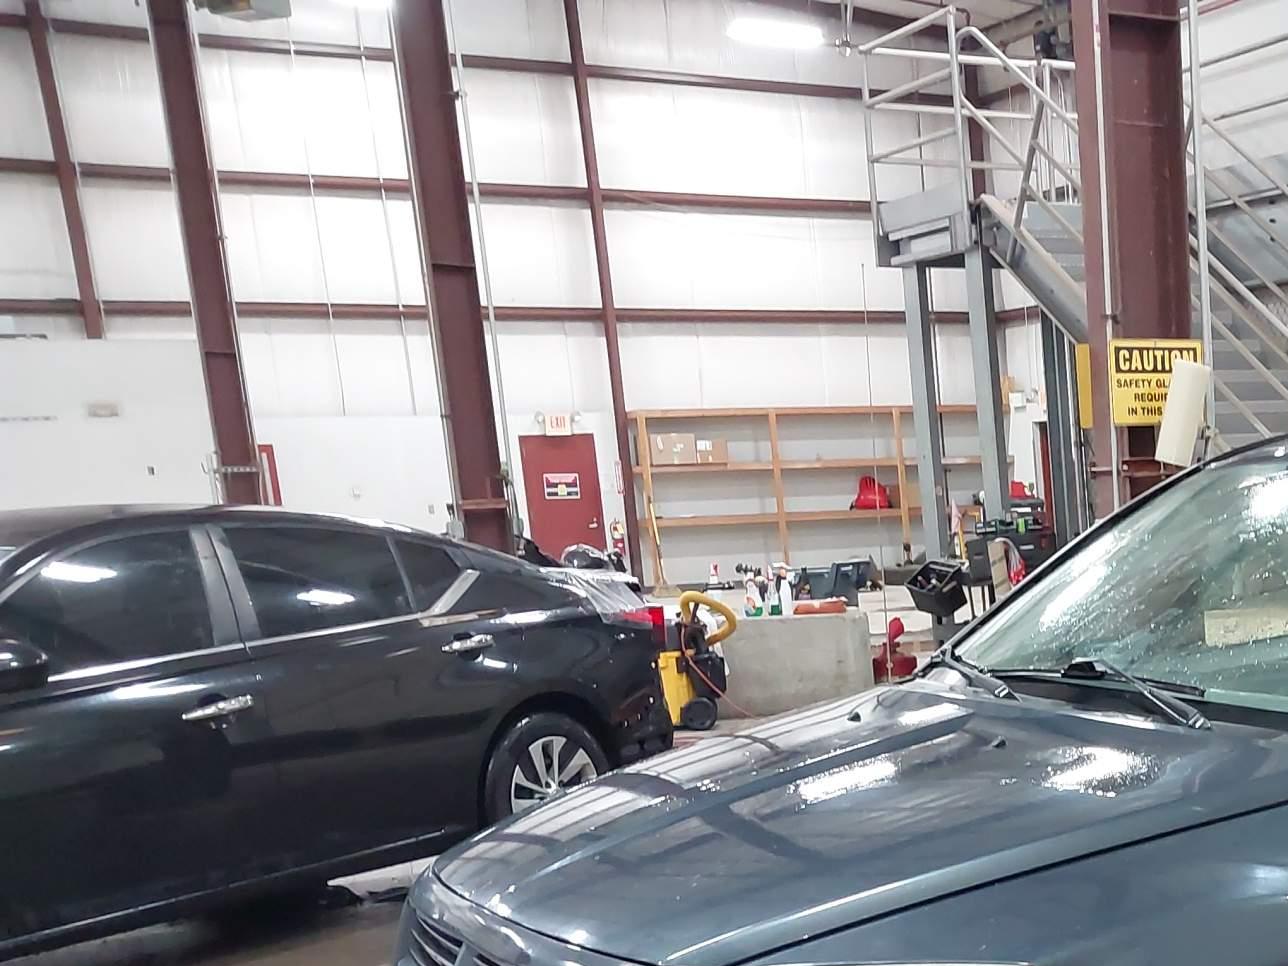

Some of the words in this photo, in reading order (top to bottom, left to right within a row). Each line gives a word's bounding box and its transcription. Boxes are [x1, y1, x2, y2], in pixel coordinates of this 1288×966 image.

[1119, 349, 1195, 372] CAUTION
[1116, 378, 1153, 389] SAFETY
[1127, 406, 1138, 417] IN
[1141, 406, 1163, 417] THIS
[550, 416, 566, 429] EXIT
